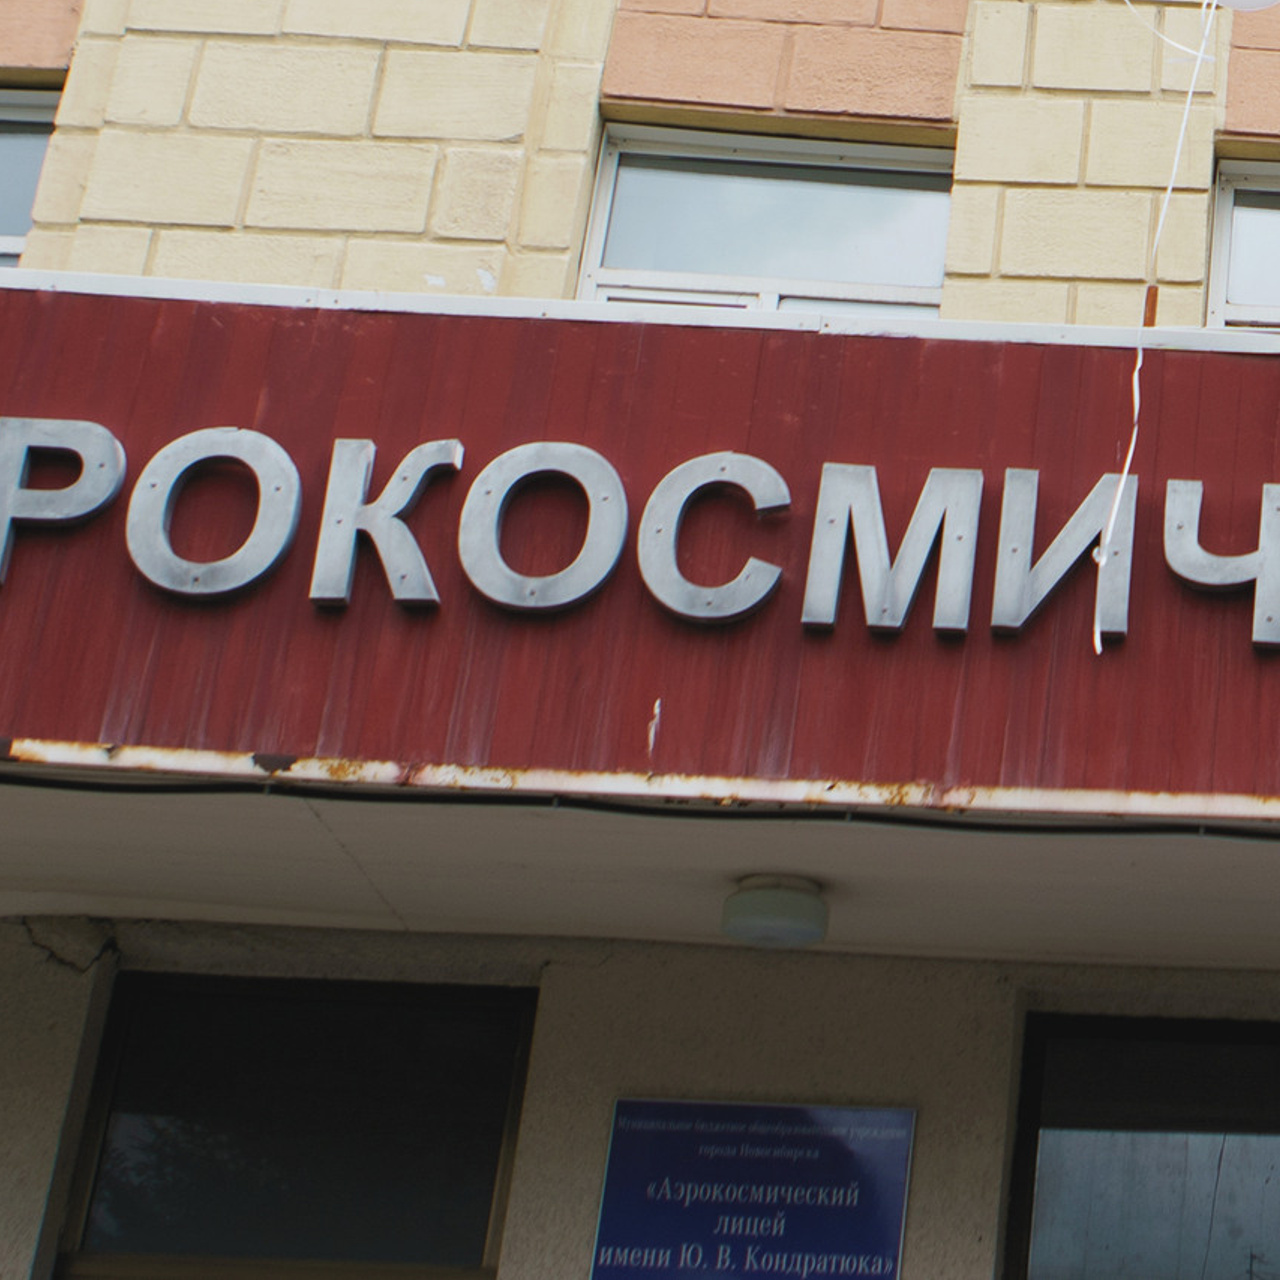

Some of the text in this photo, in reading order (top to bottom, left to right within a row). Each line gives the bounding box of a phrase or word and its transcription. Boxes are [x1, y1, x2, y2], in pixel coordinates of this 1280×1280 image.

[647, 1177, 860, 1207] «Аэрокосмический
[713, 1210, 787, 1237] лицей
[599, 1245, 672, 1268] имени
[744, 1245, 894, 1278] Кондратюка»
